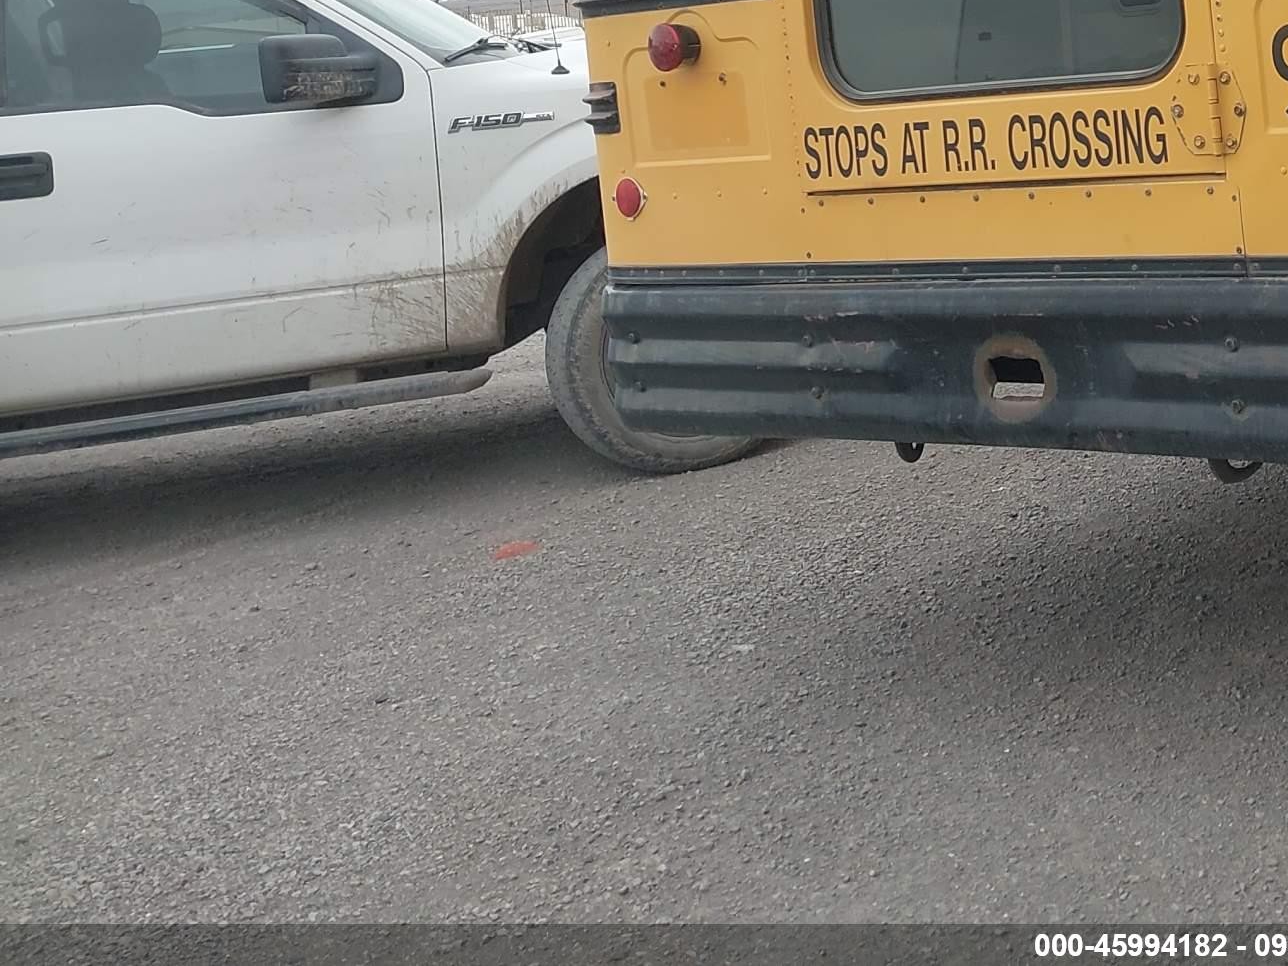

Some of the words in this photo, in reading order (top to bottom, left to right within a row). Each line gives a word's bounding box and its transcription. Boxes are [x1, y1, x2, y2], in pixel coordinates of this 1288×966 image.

[448, 112, 523, 134] F-150
[804, 122, 889, 180] STOPS
[901, 121, 930, 175] AT
[942, 118, 996, 172] R.R.
[1008, 106, 1169, 171] CROSSING
